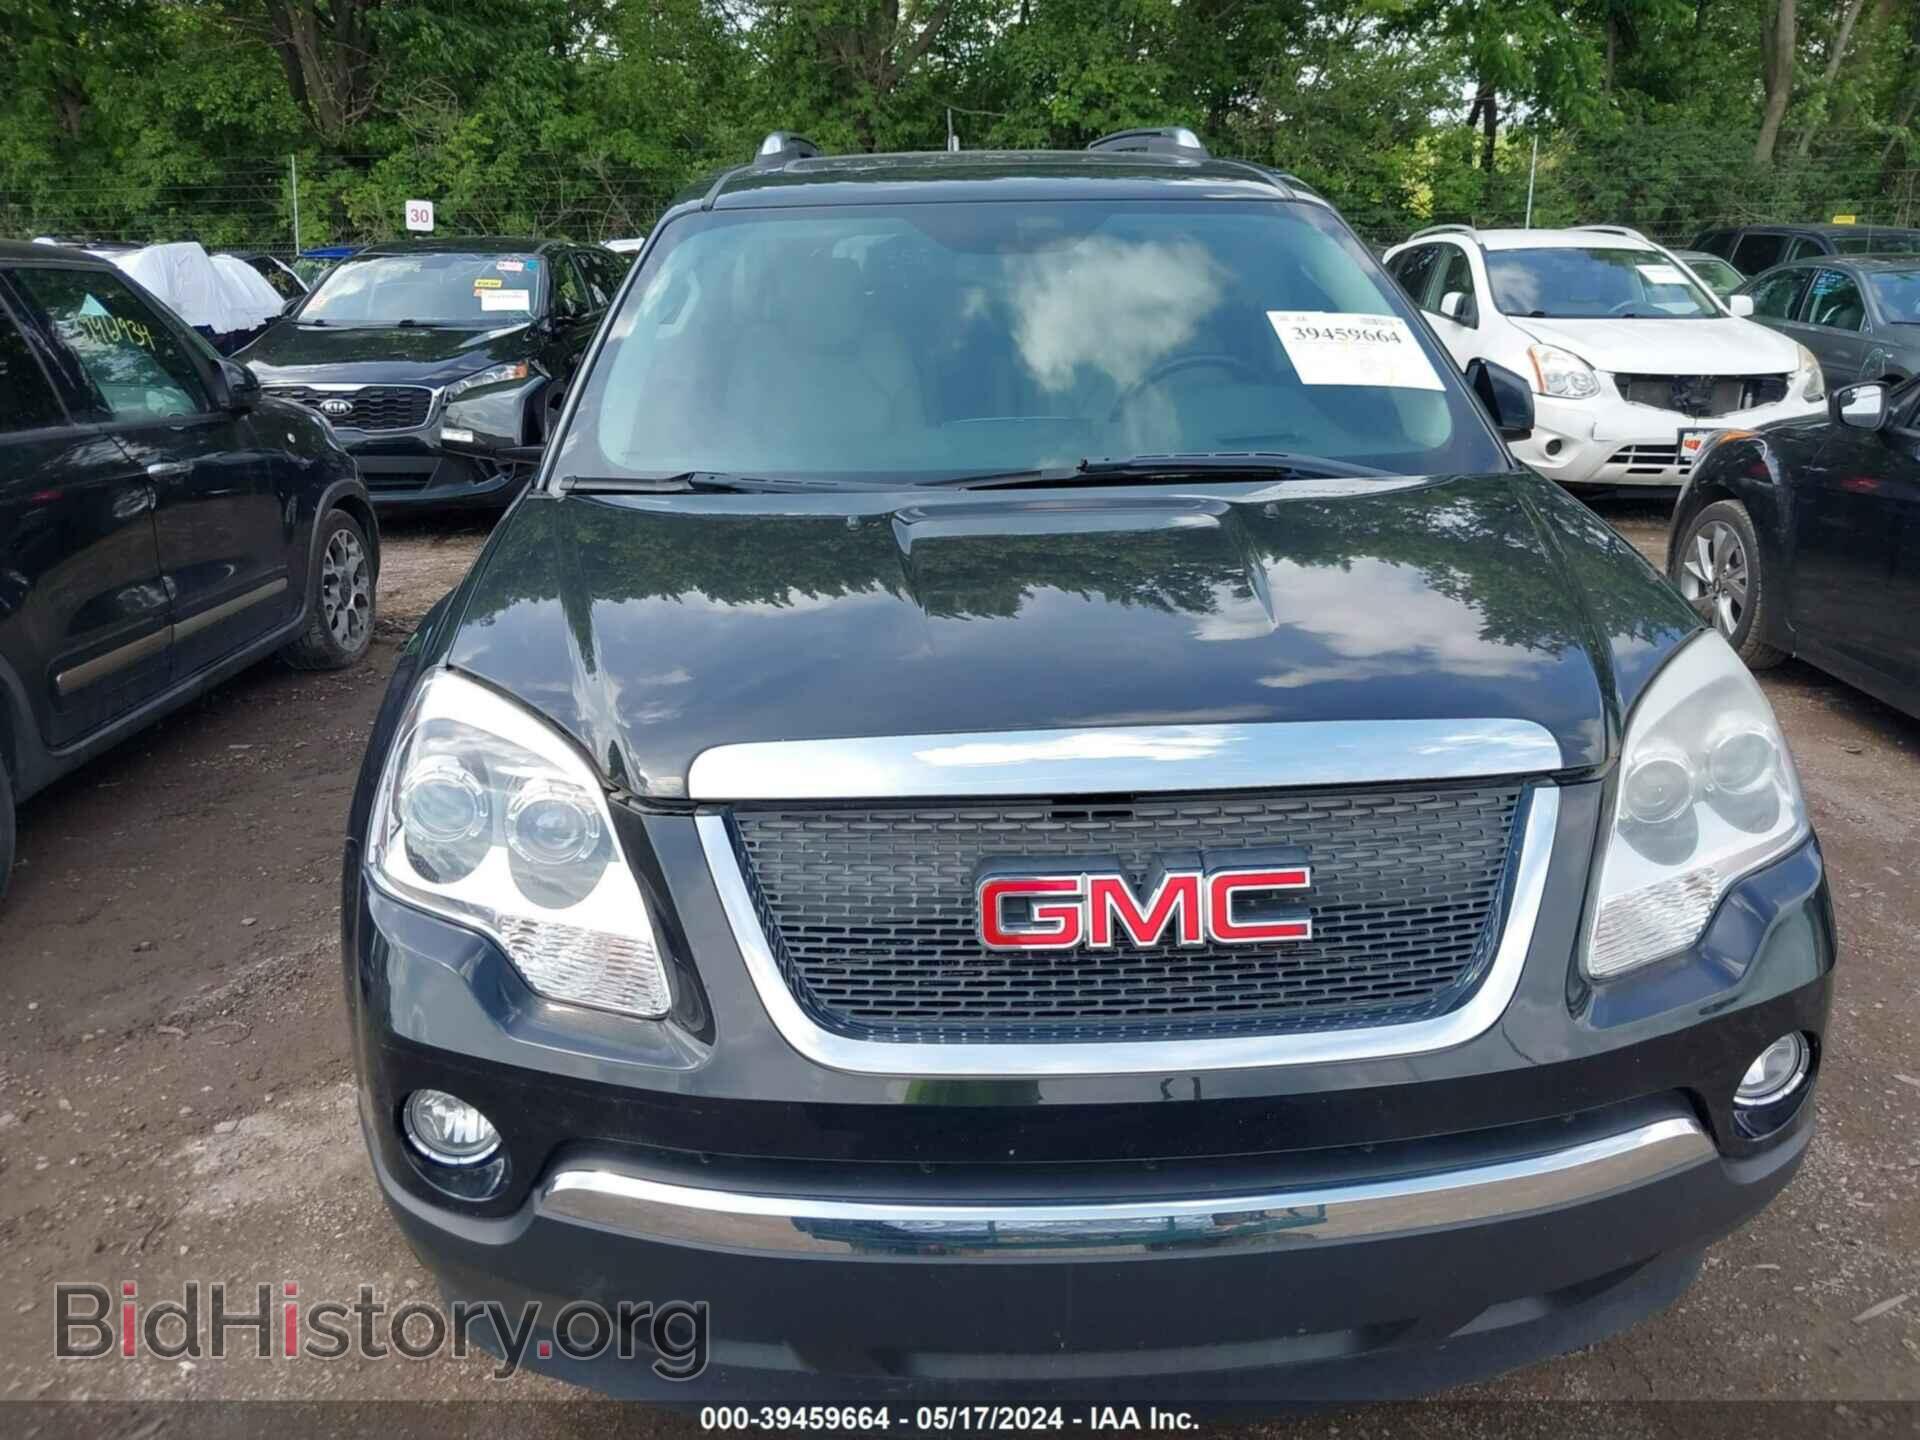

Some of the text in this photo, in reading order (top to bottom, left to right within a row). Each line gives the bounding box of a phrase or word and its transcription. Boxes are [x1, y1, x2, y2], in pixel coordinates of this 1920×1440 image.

[410, 208, 430, 224] 30
[1291, 326, 1403, 345] 39459664
[322, 401, 350, 414] KIA
[975, 865, 1314, 950] GMC
